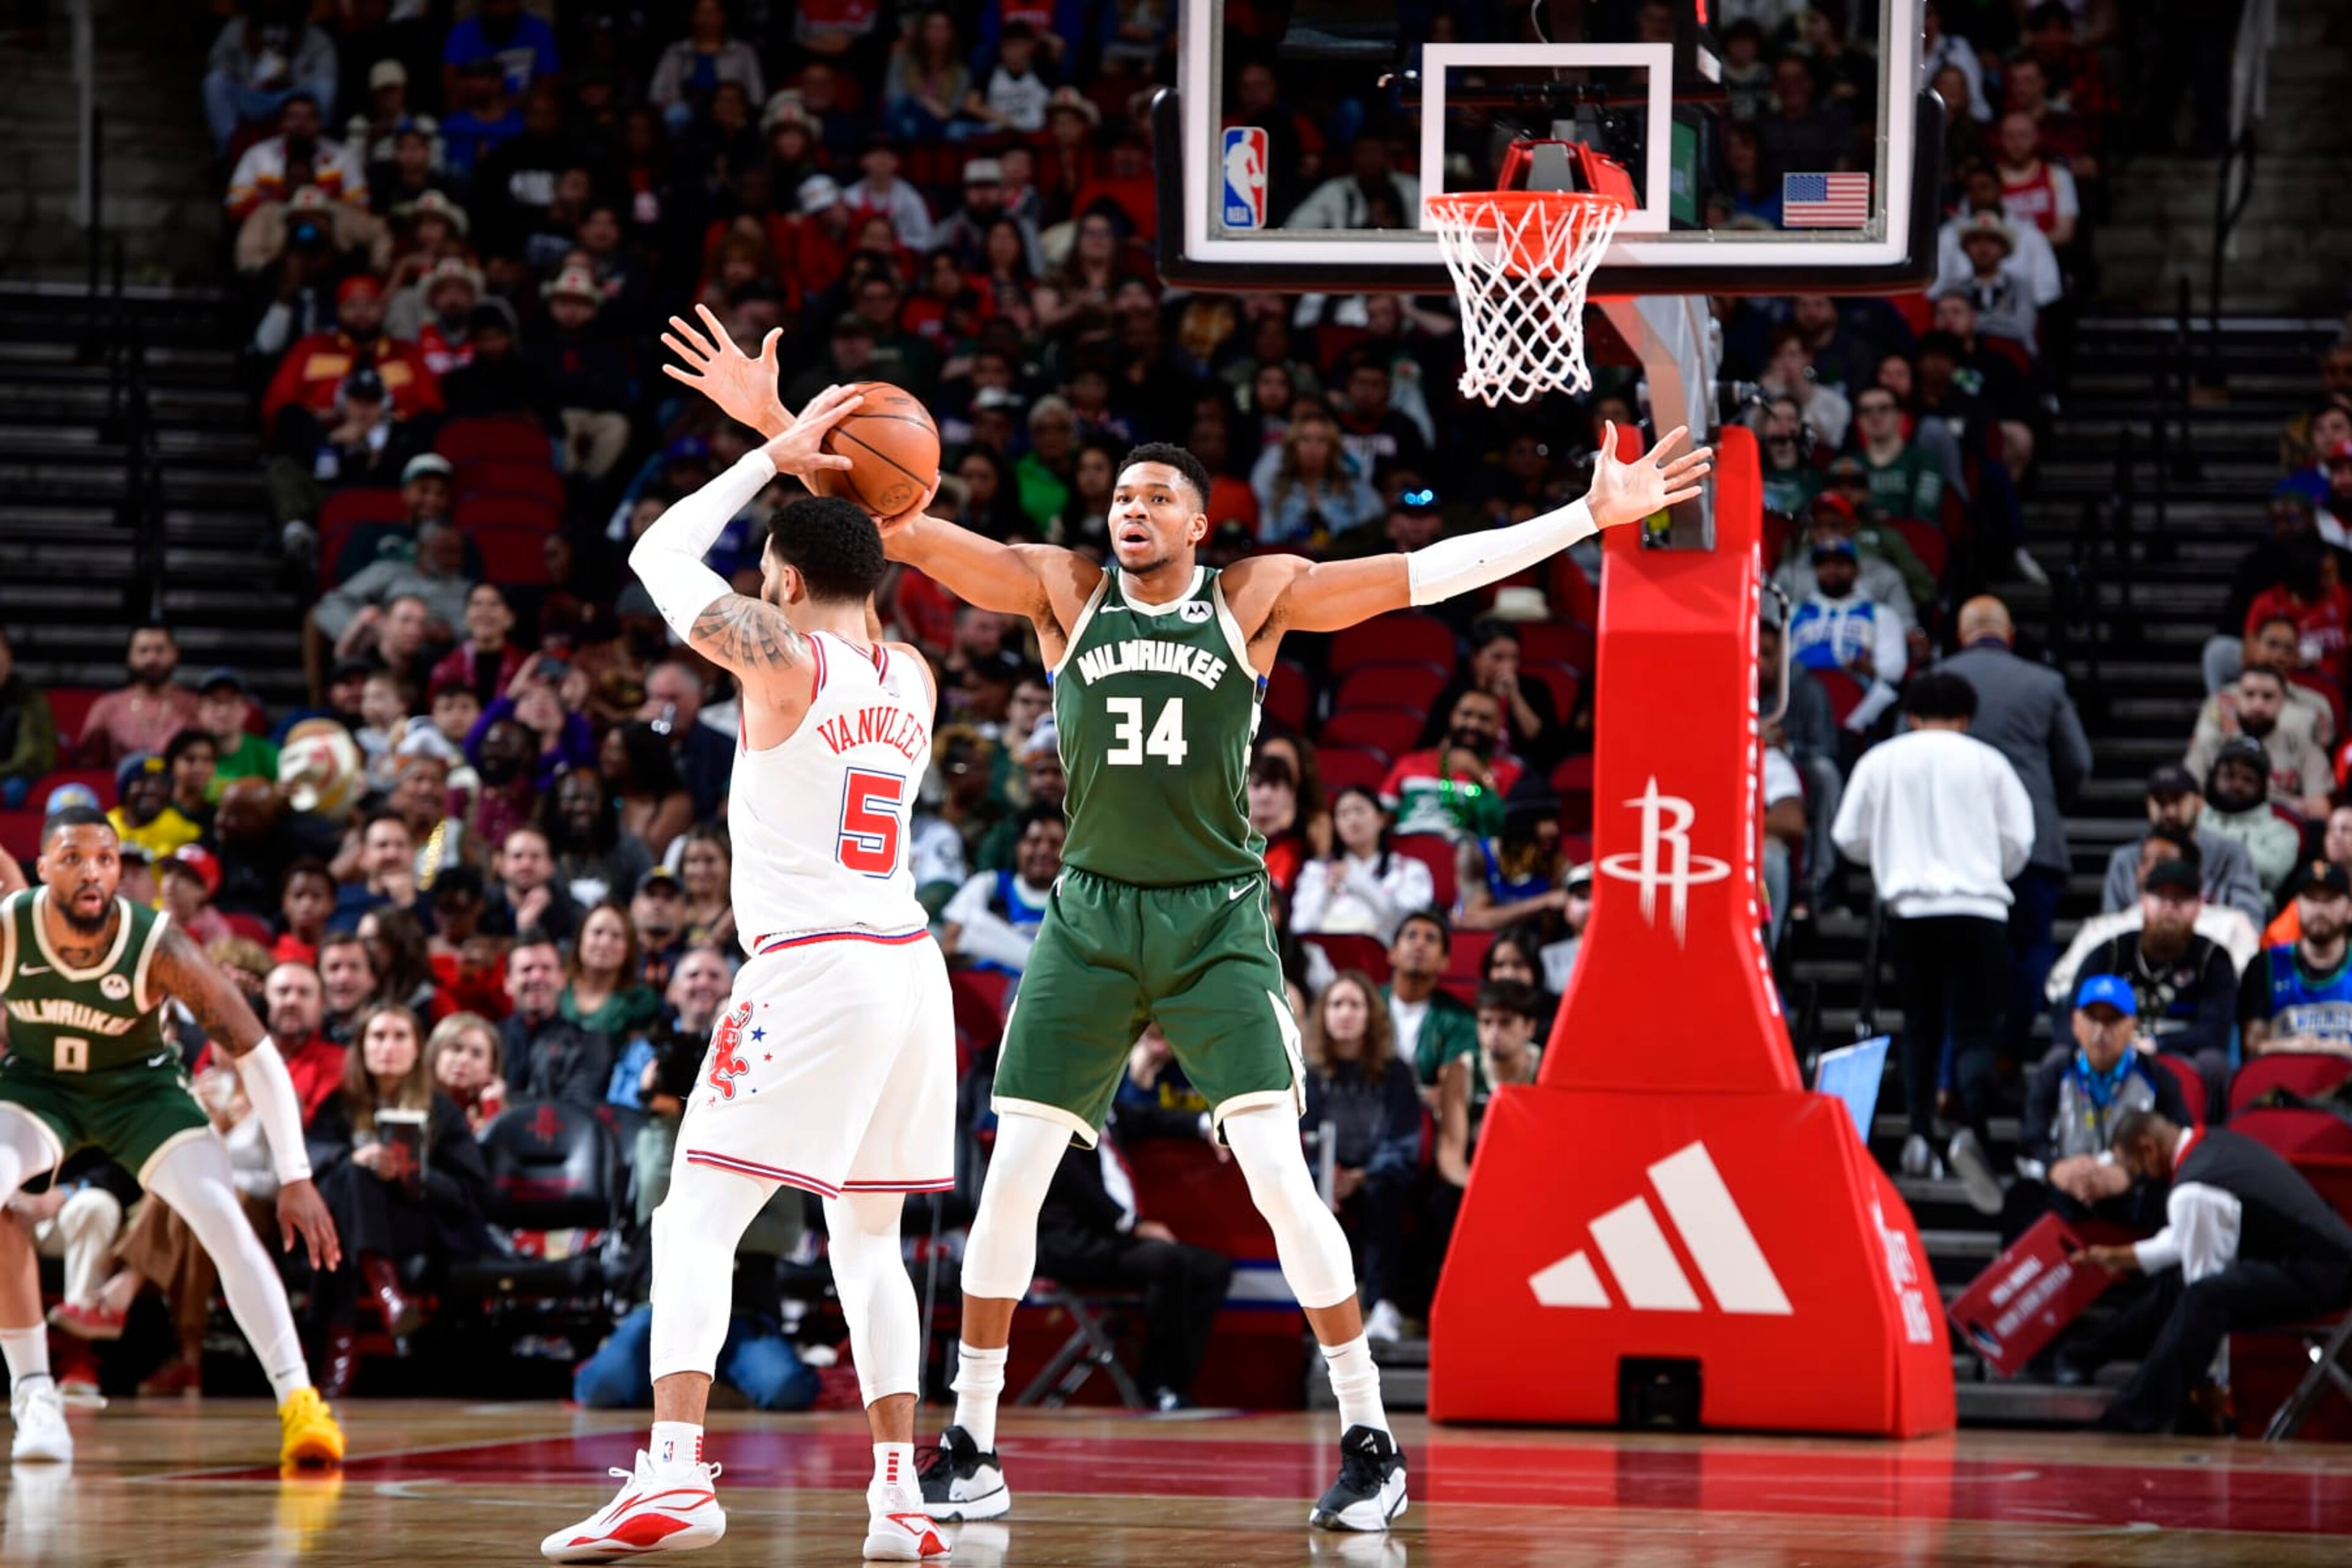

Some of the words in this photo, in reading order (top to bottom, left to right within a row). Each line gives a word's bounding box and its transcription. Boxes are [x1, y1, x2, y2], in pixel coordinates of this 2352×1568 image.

[1077, 639, 1227, 690] MILWAUKEE
[816, 706, 927, 765] VANVLEET
[1106, 697, 1188, 765] 34
[835, 767, 906, 880] 5
[54, 1036, 89, 1073] 0
